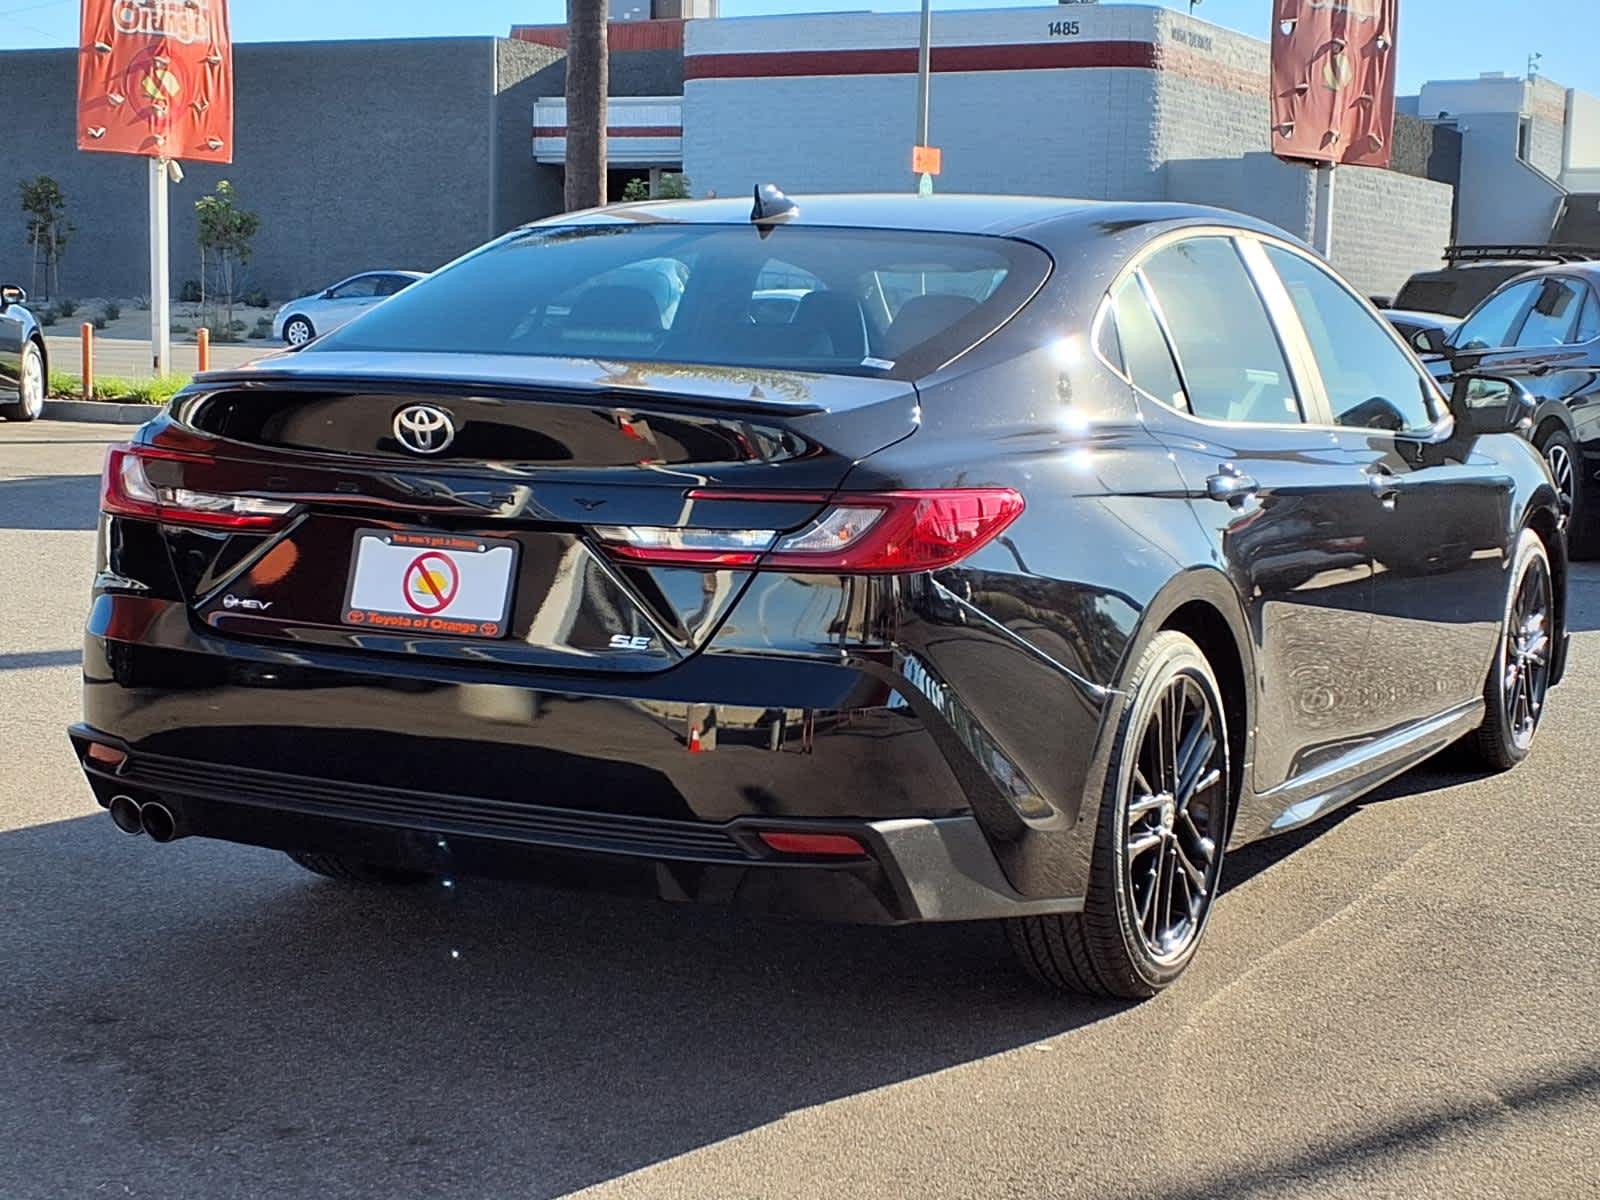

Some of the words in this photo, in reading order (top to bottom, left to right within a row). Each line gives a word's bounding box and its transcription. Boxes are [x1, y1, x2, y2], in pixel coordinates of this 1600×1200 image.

[1047, 20, 1080, 36] 1485
[367, 611, 411, 628] Toyota
[414, 617, 428, 629] of
[430, 618, 477, 633] Orange
[608, 634, 651, 650] SE
